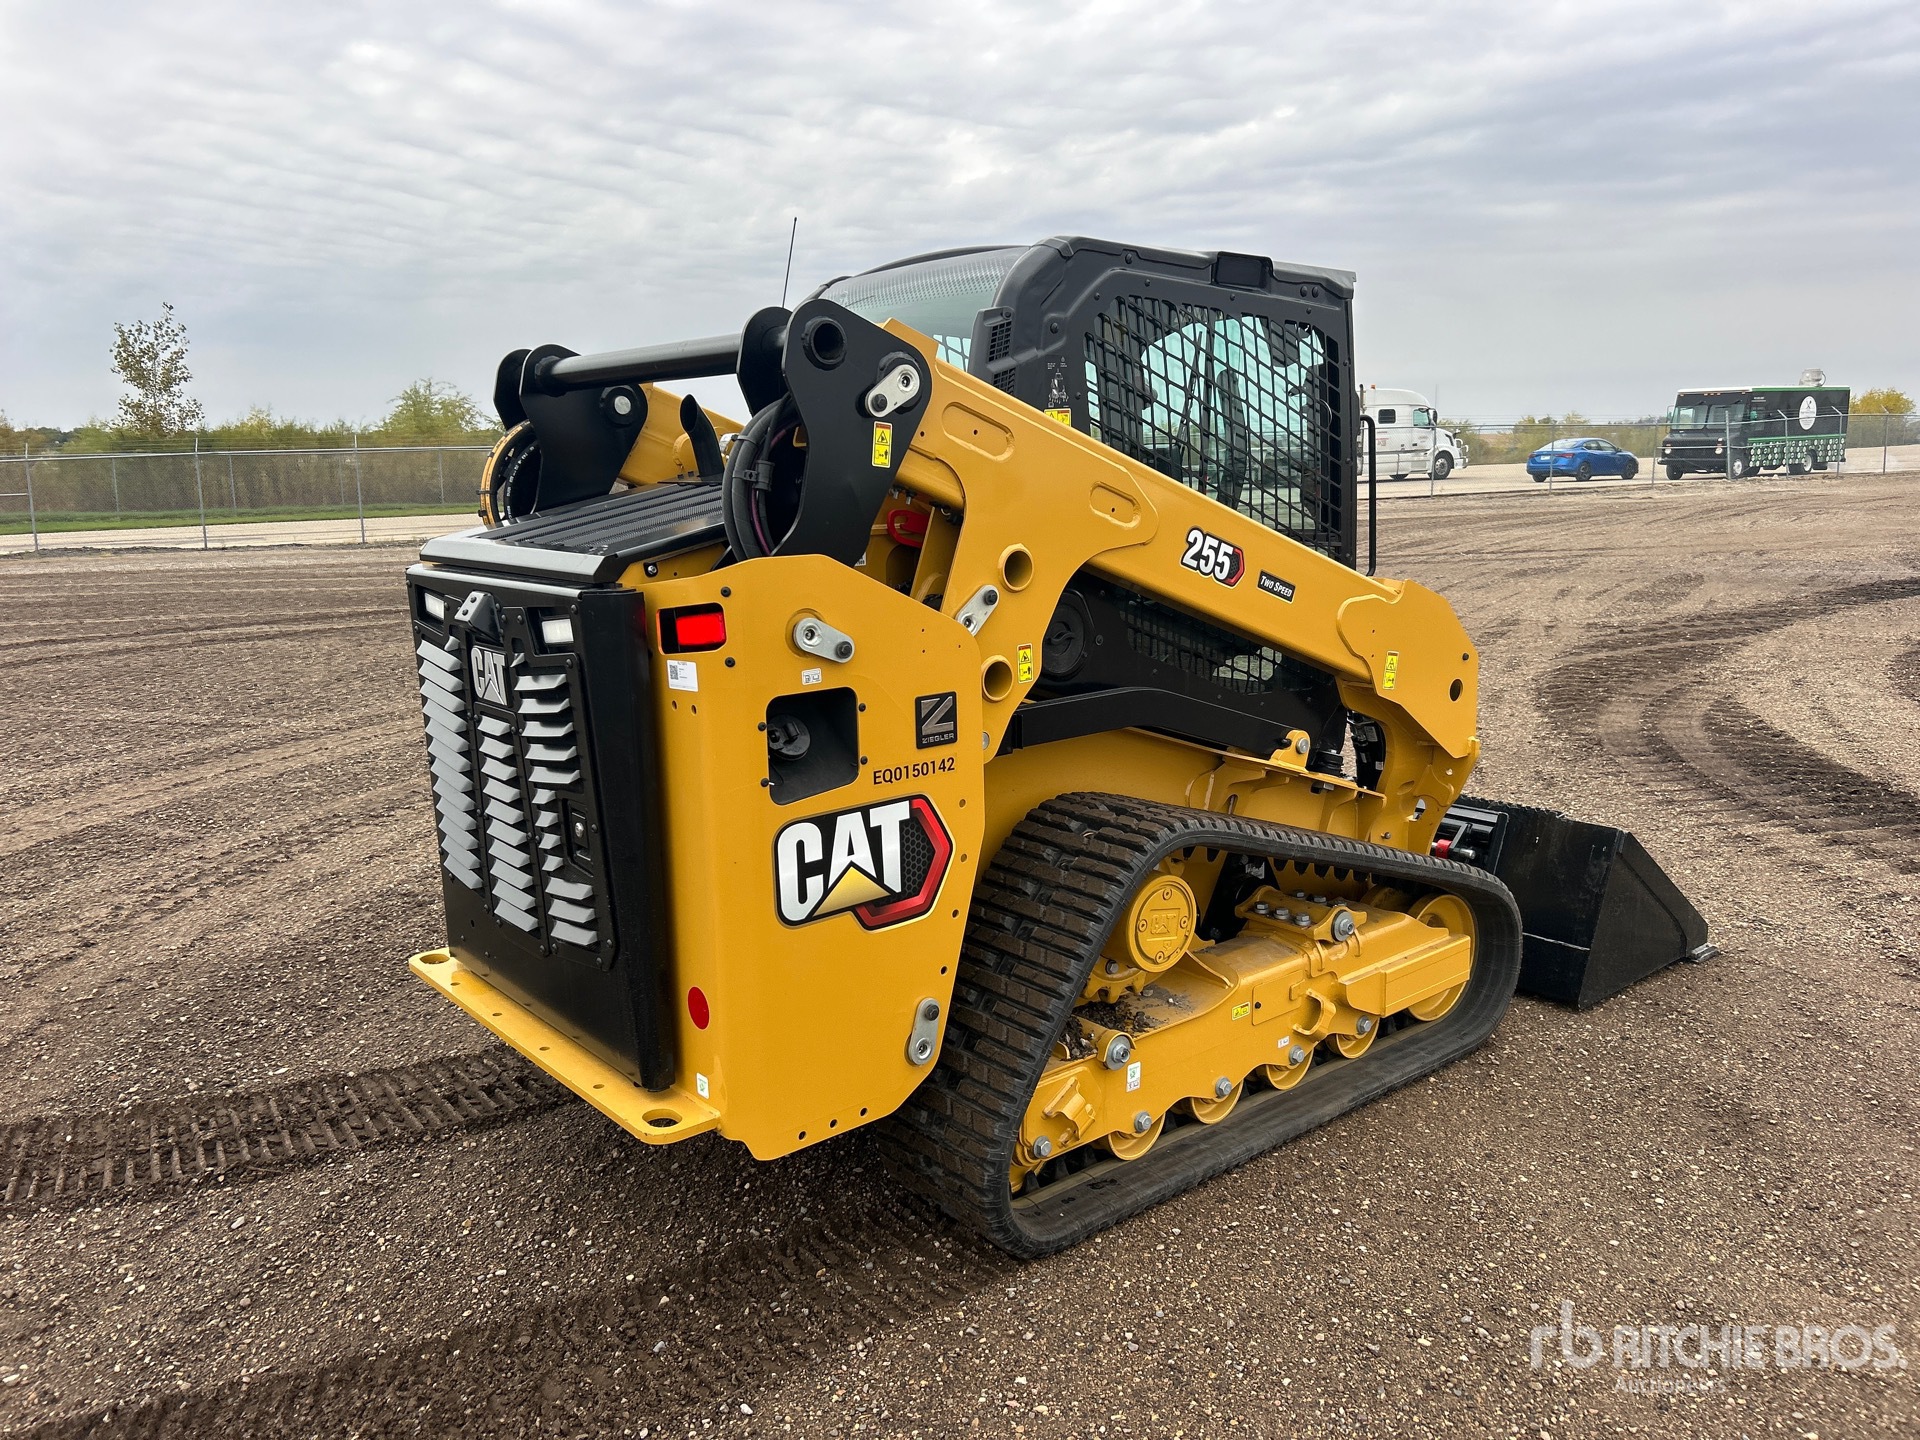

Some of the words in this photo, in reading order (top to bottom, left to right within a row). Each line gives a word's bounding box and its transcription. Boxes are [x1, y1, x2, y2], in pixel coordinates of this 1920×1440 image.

[1182, 529, 1234, 580] 255
[1260, 575, 1274, 589] TWO
[1274, 581, 1293, 598] SPEED
[471, 646, 507, 706] CAT
[921, 732, 955, 744] ZIEGLER
[873, 756, 955, 785] EQ0150142
[777, 800, 911, 922] CAT
[1150, 913, 1177, 935] CAT
